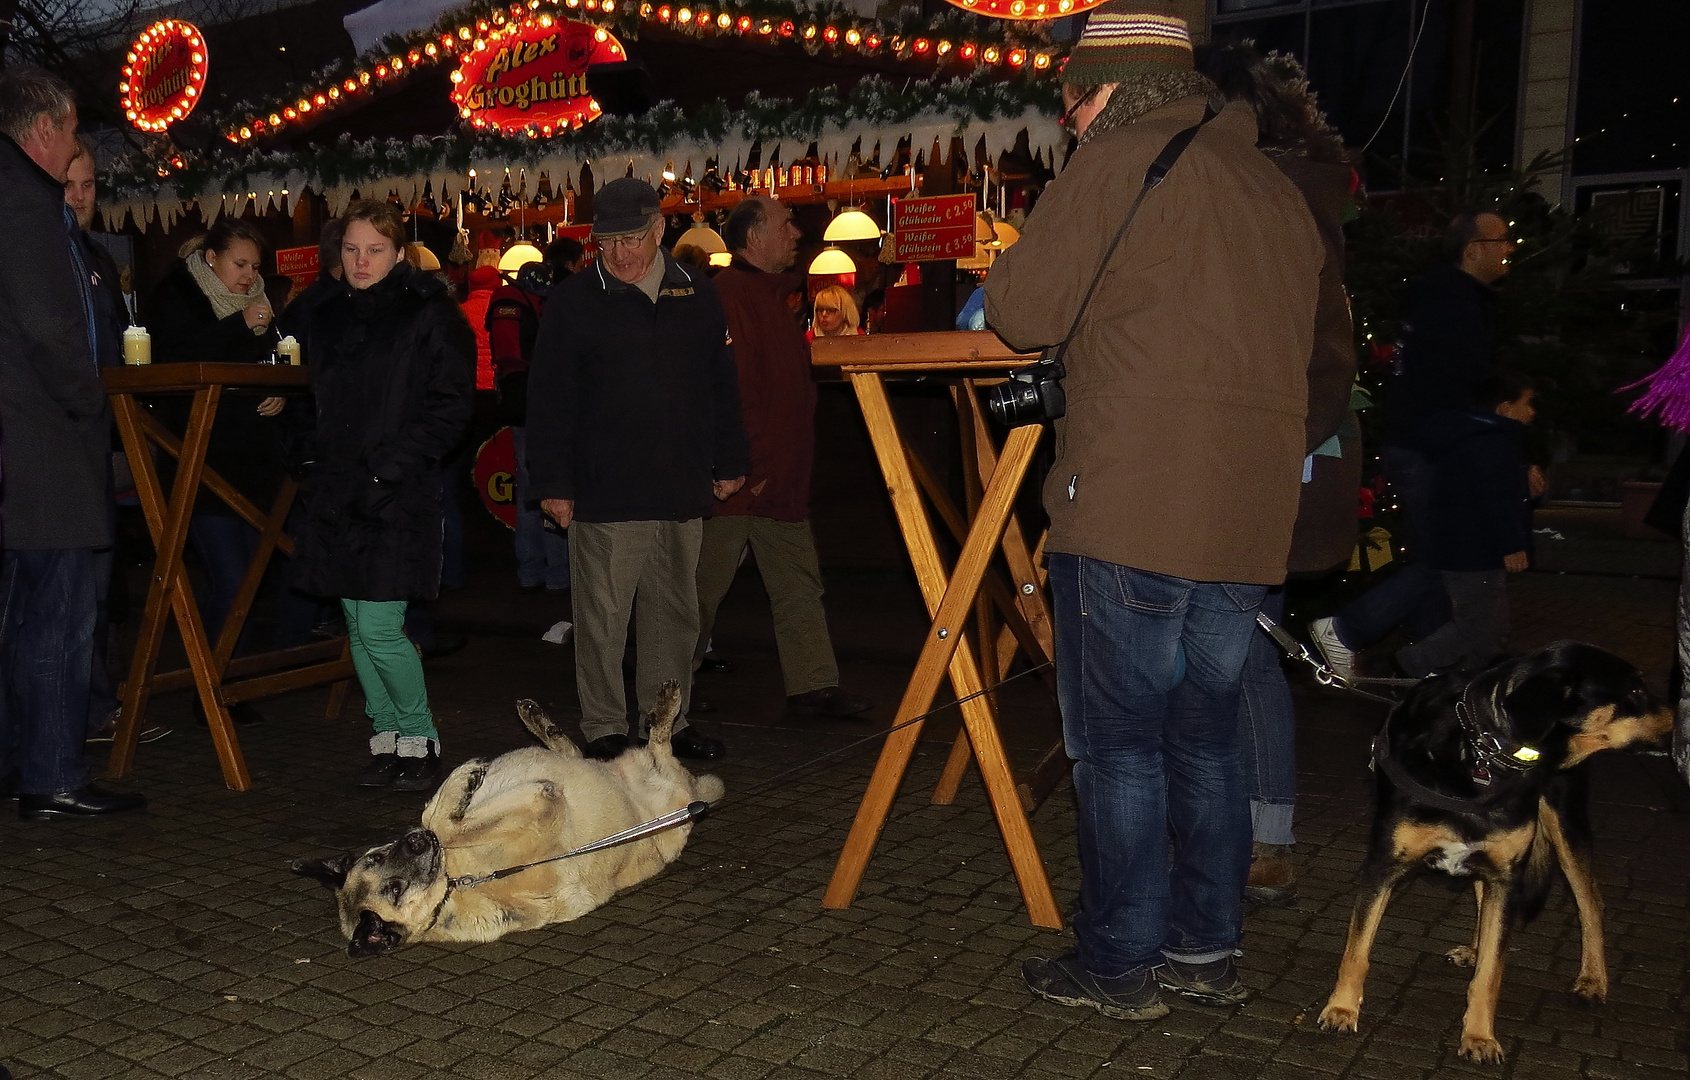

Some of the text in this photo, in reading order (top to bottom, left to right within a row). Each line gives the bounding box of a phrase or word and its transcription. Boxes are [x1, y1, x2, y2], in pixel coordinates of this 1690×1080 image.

[143, 36, 172, 87] Alex
[486, 33, 560, 83] Alex
[136, 65, 197, 112] Groghütt
[466, 71, 590, 110] Groghütt
[898, 214, 942, 228] Glühwein
[953, 199, 973, 218] 2,50
[904, 203, 936, 215] Weißer
[898, 243, 942, 256] Glühwein
[953, 233, 973, 251] 3,50
[904, 231, 936, 243] Weißer
